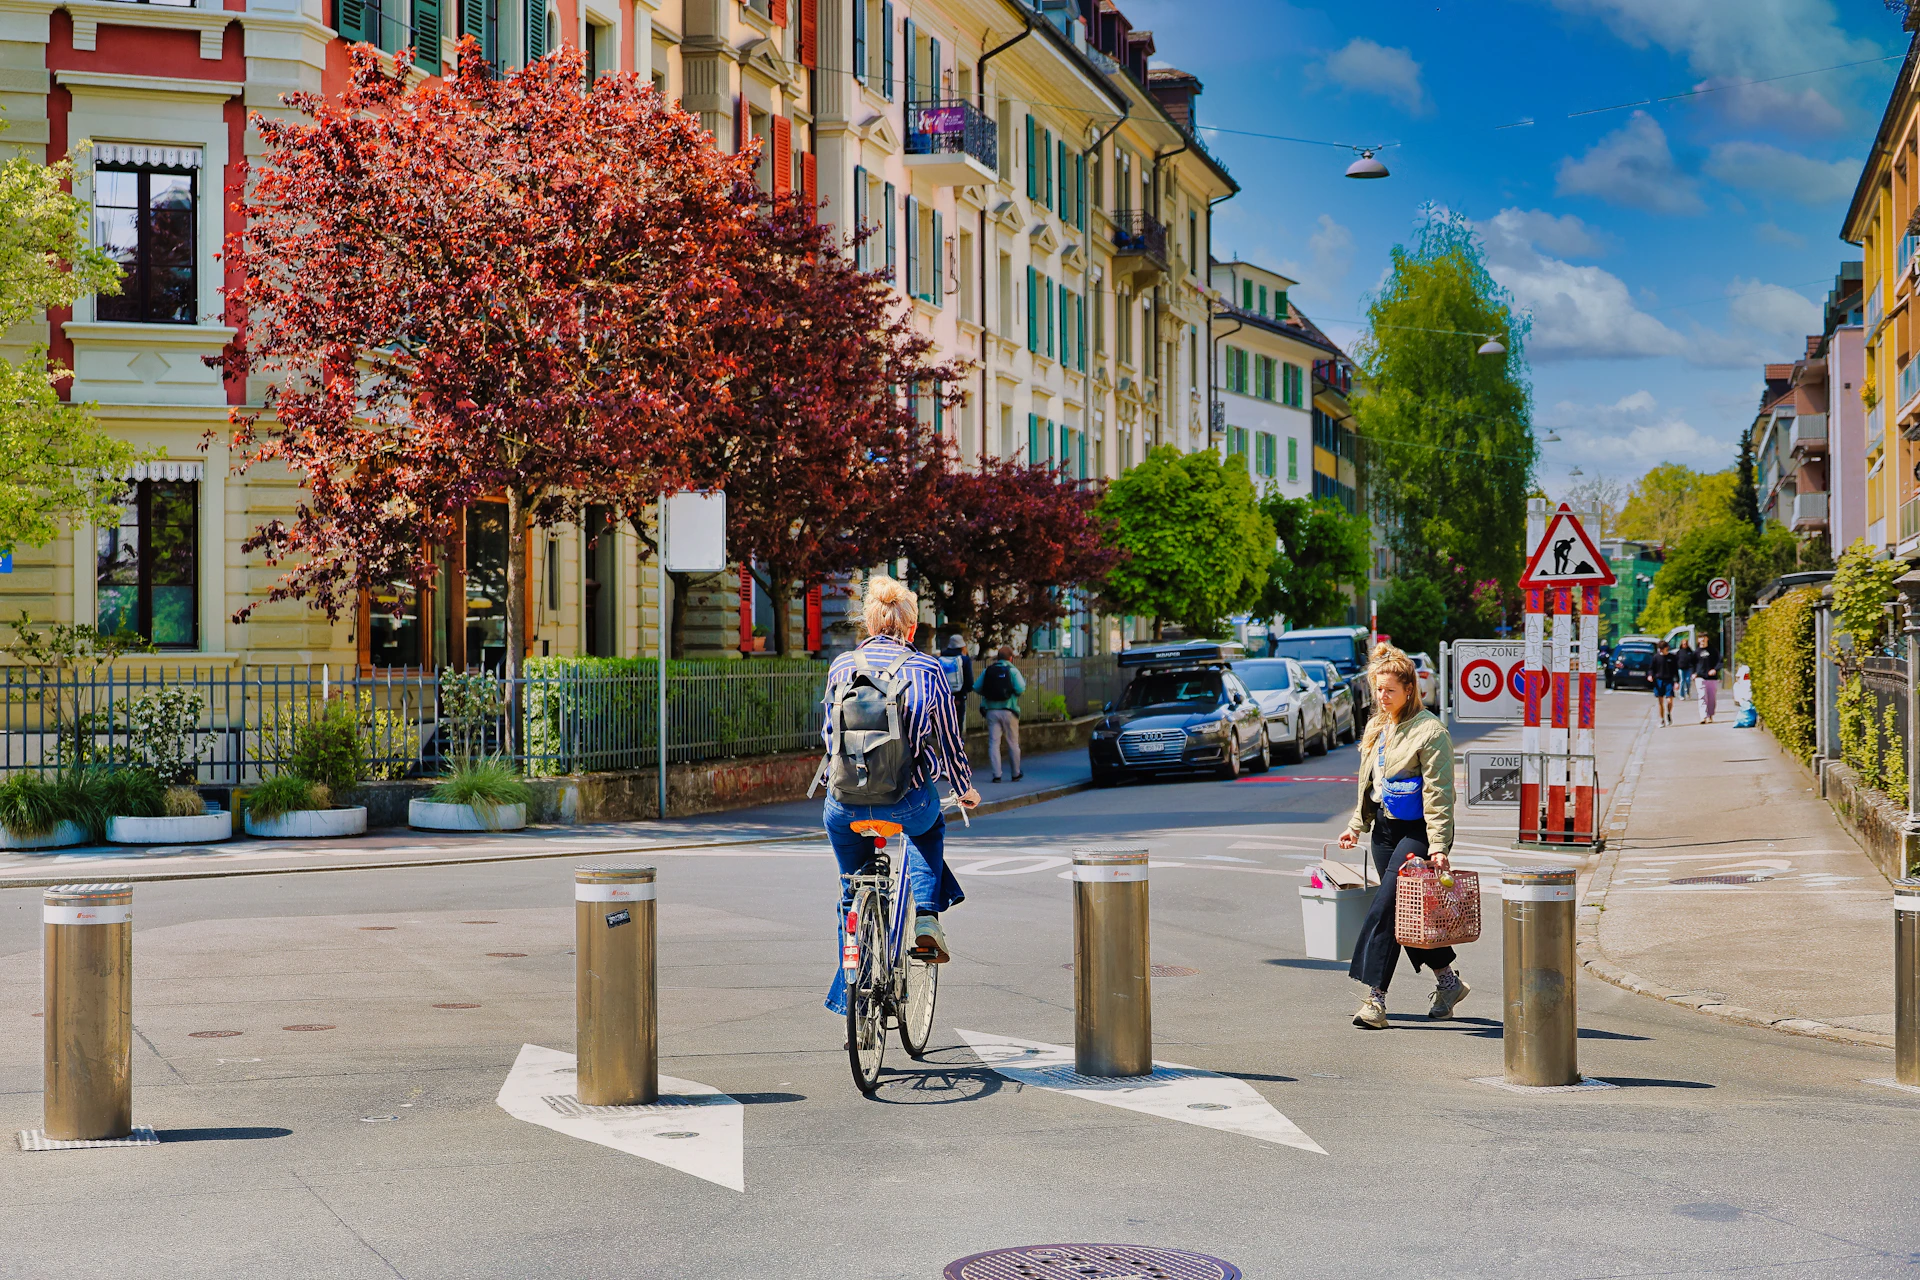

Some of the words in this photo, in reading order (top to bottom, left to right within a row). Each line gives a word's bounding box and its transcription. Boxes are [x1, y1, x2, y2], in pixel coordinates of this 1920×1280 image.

[1491, 647, 1519, 657] ZONE
[1473, 673, 1491, 688] 30
[1490, 757, 1520, 767] ZONE
